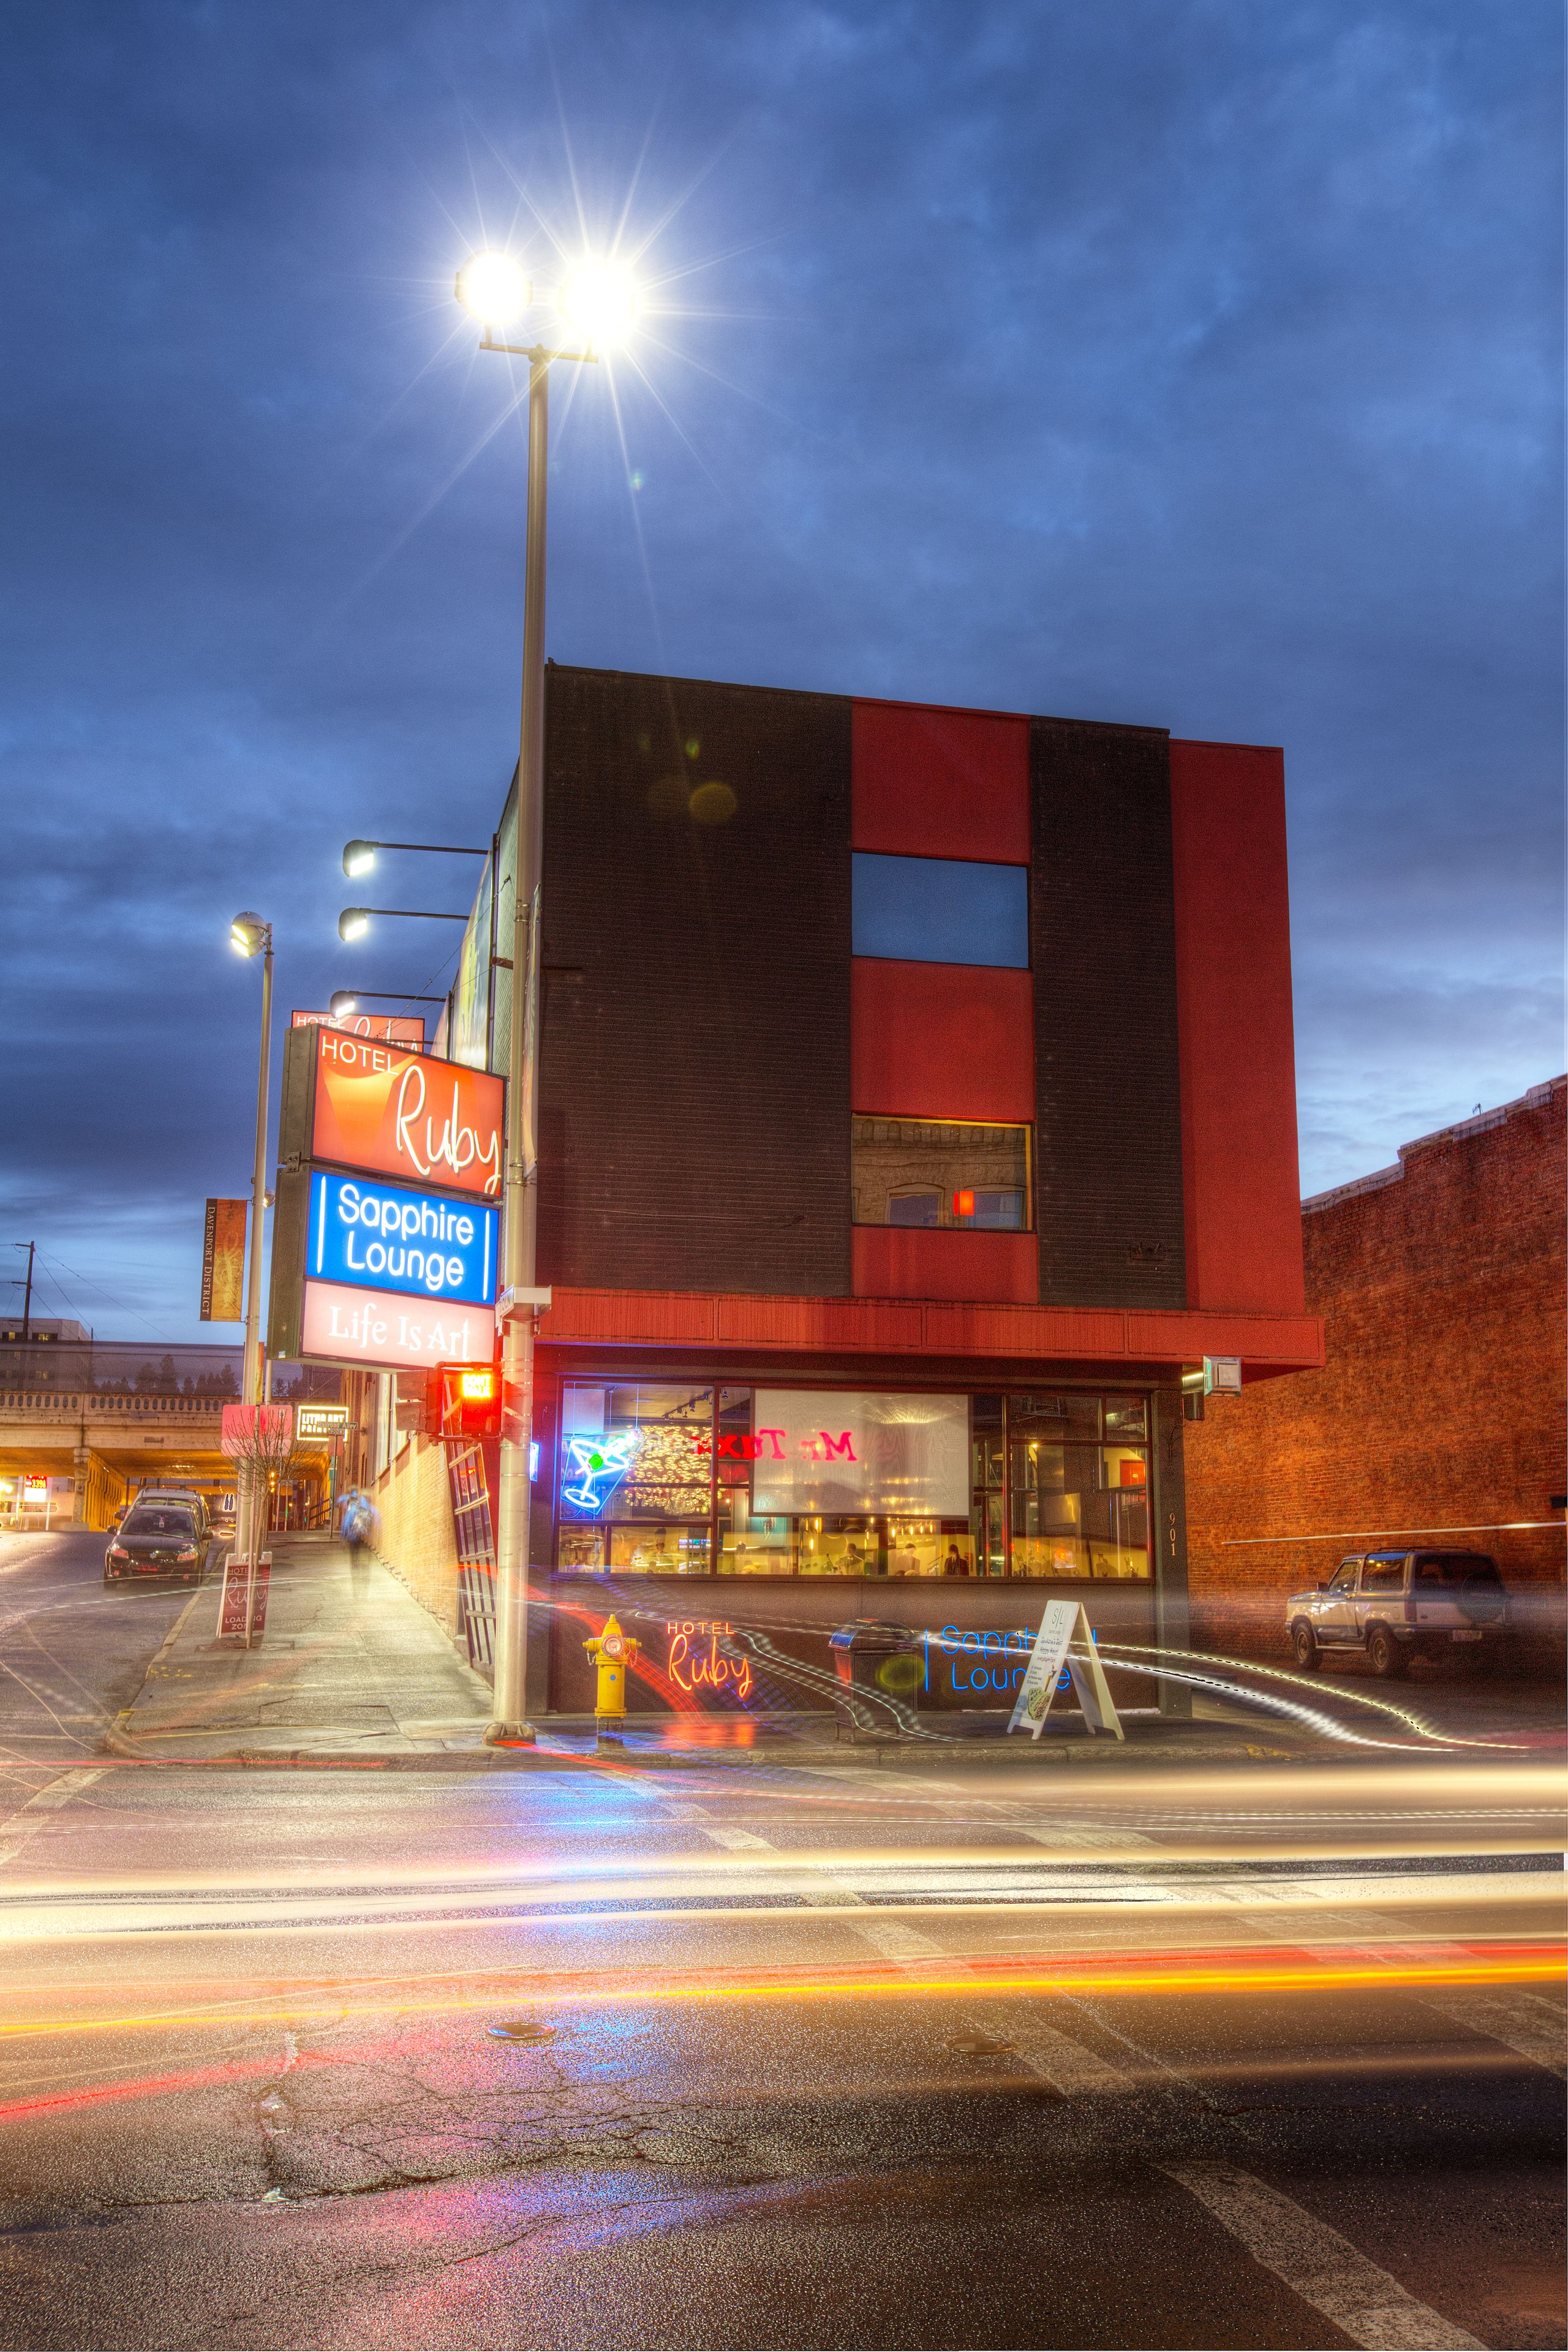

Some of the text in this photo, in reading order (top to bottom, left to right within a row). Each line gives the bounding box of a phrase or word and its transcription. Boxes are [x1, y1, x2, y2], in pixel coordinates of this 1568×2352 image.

[297, 1016, 345, 1029] HOTEL
[322, 1036, 399, 1077] HOTEL
[395, 1065, 501, 1194] Ruby
[338, 1183, 474, 1244] Sapphire
[202, 1207, 215, 1314] DAVENPORT DISTRICT
[348, 1231, 464, 1291] Lounge
[328, 1302, 471, 1362] Life Is Art
[225, 1577, 267, 1611] Ruy
[667, 1622, 735, 1635] HOTEL
[941, 1625, 1039, 1660] Sapph
[668, 1634, 753, 1698] Ruby
[951, 1661, 1071, 1691] Loune
